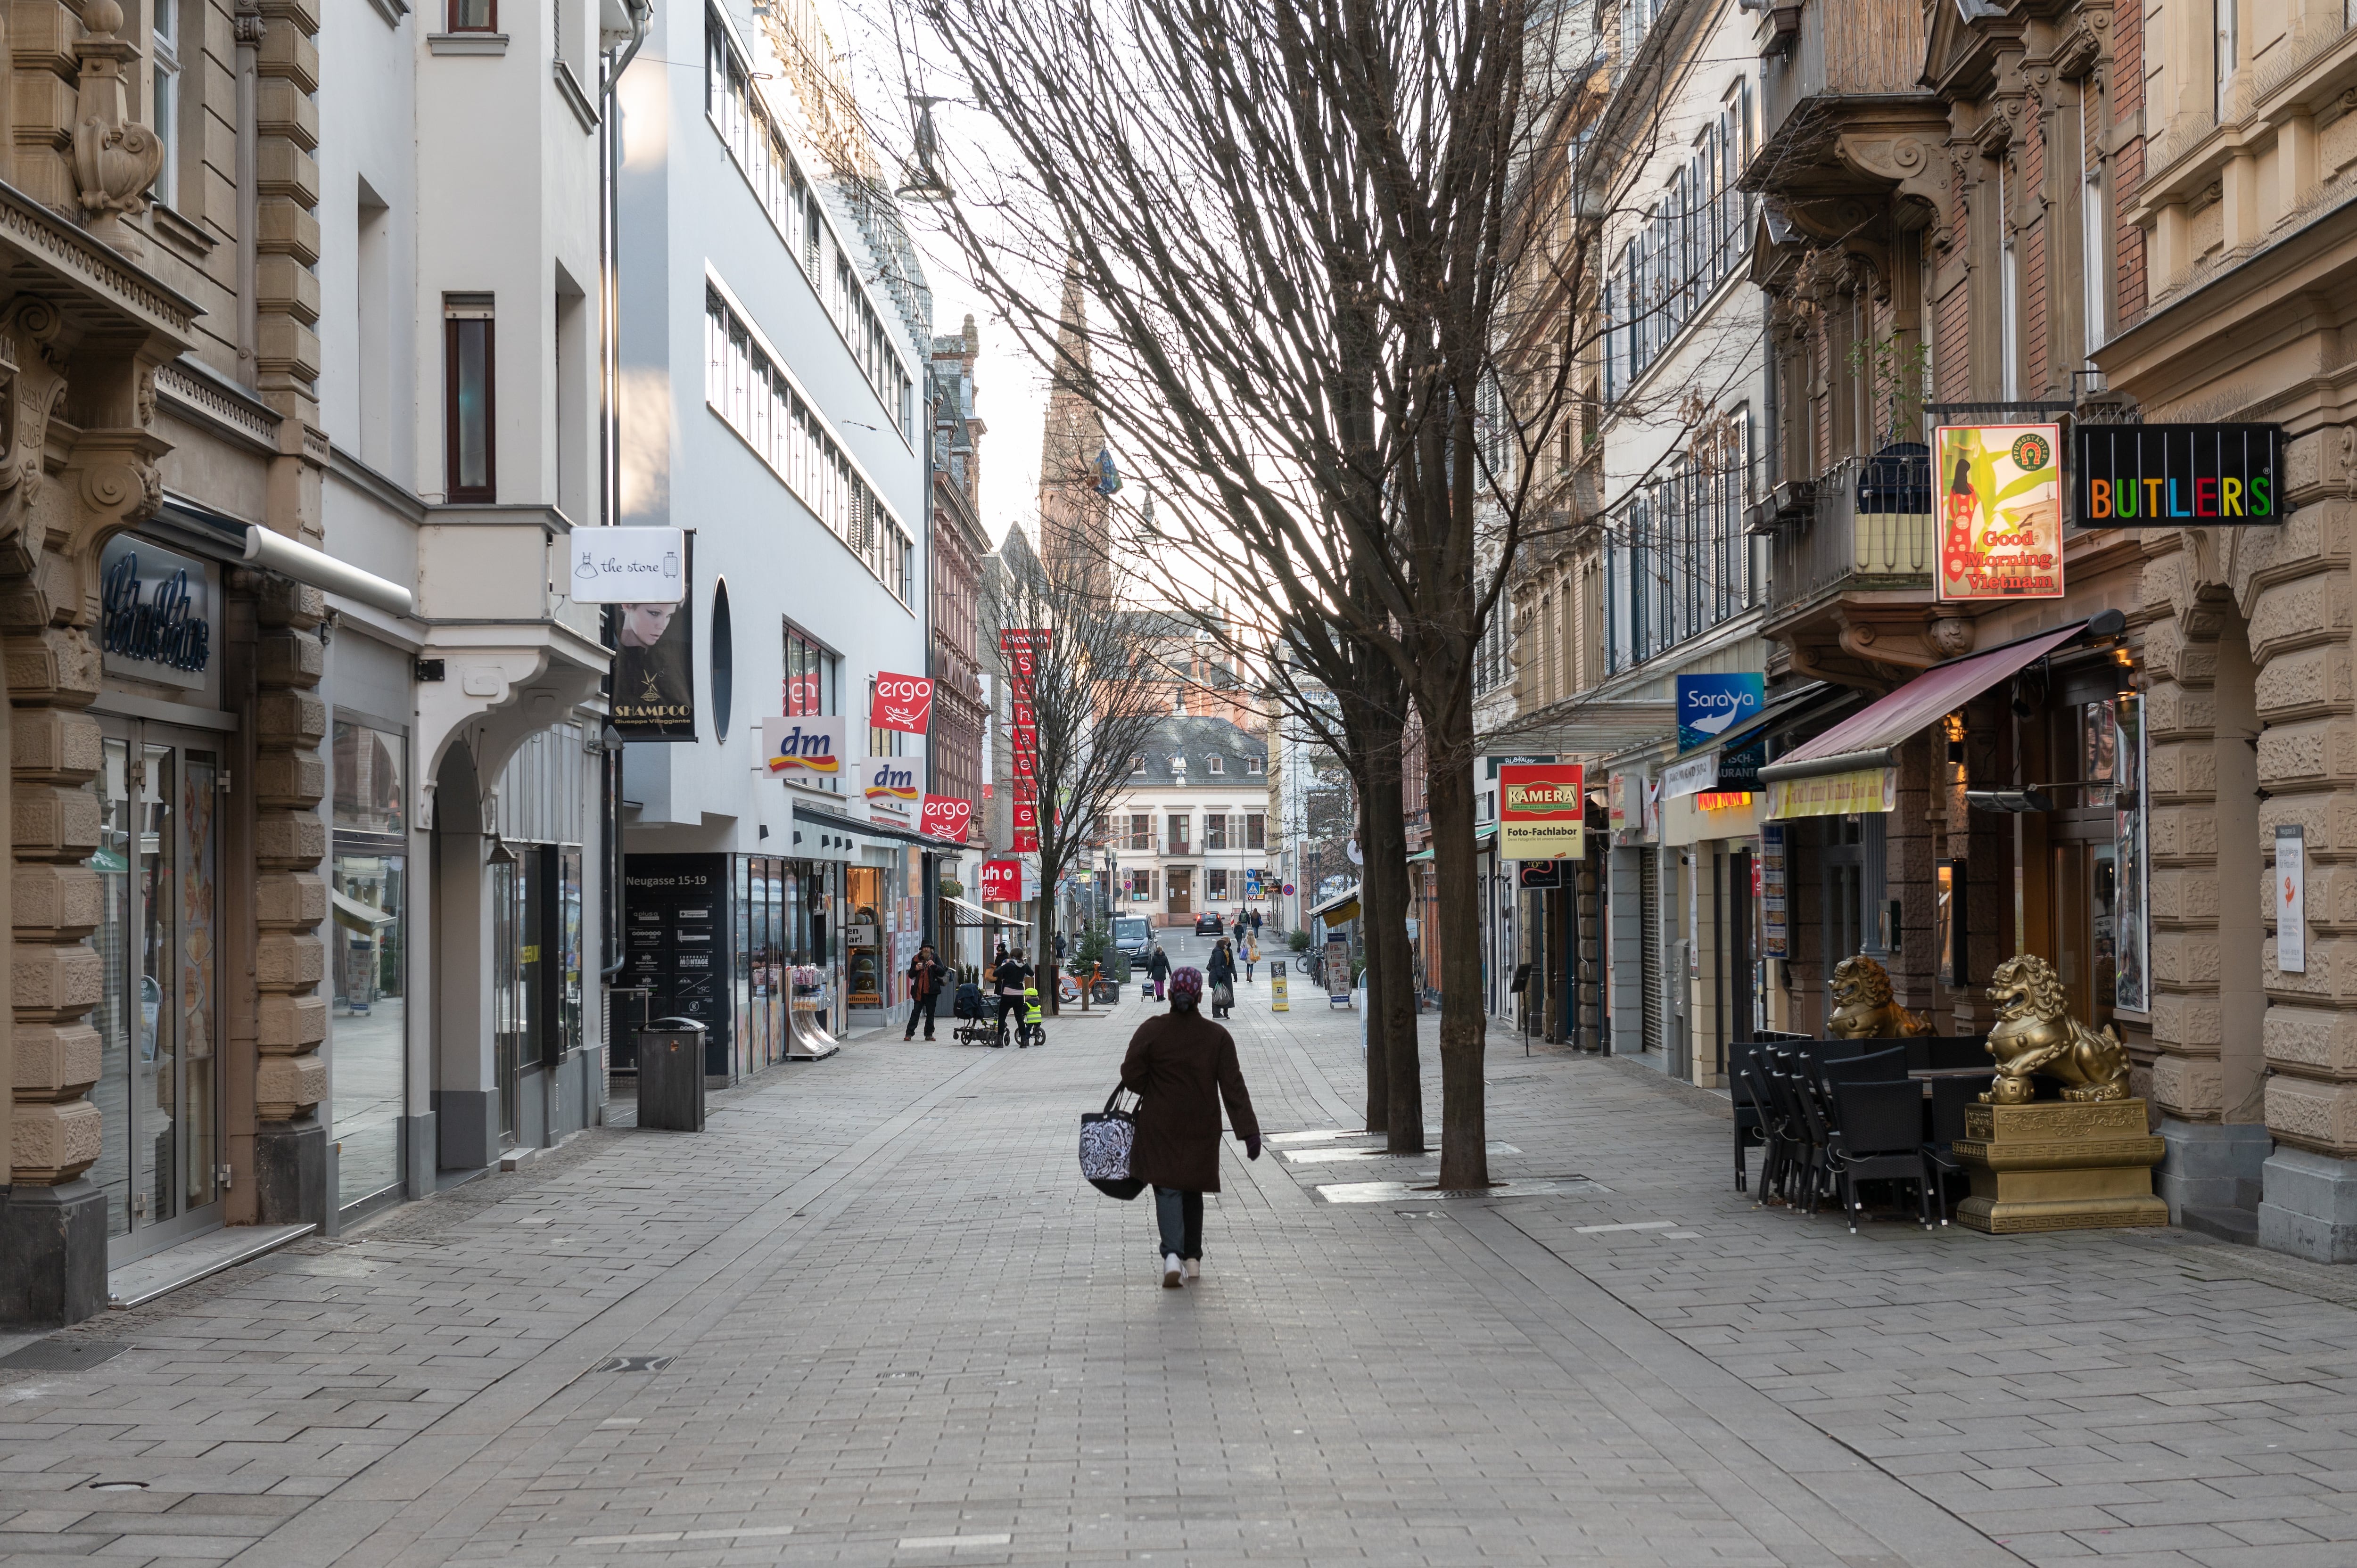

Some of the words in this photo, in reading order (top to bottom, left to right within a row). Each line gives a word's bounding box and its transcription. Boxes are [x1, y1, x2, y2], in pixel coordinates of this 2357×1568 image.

[2091, 476, 2271, 518] BUTLERS
[1983, 530, 2035, 547] Good
[601, 557, 623, 572] the
[627, 561, 659, 572] store
[1965, 551, 2053, 570] Morning
[1965, 574, 2053, 590] Vietnam
[877, 679, 931, 703] ergo
[615, 705, 690, 717] SHAMPOO
[780, 726, 831, 756] dm
[874, 763, 913, 786] dm
[1508, 790, 1575, 802] KAMERA
[925, 801, 970, 821] ergo
[1508, 827, 1577, 837] Foto-Fachlabor
[626, 876, 675, 887] Neugasse
[678, 876, 707, 886] 15-19
